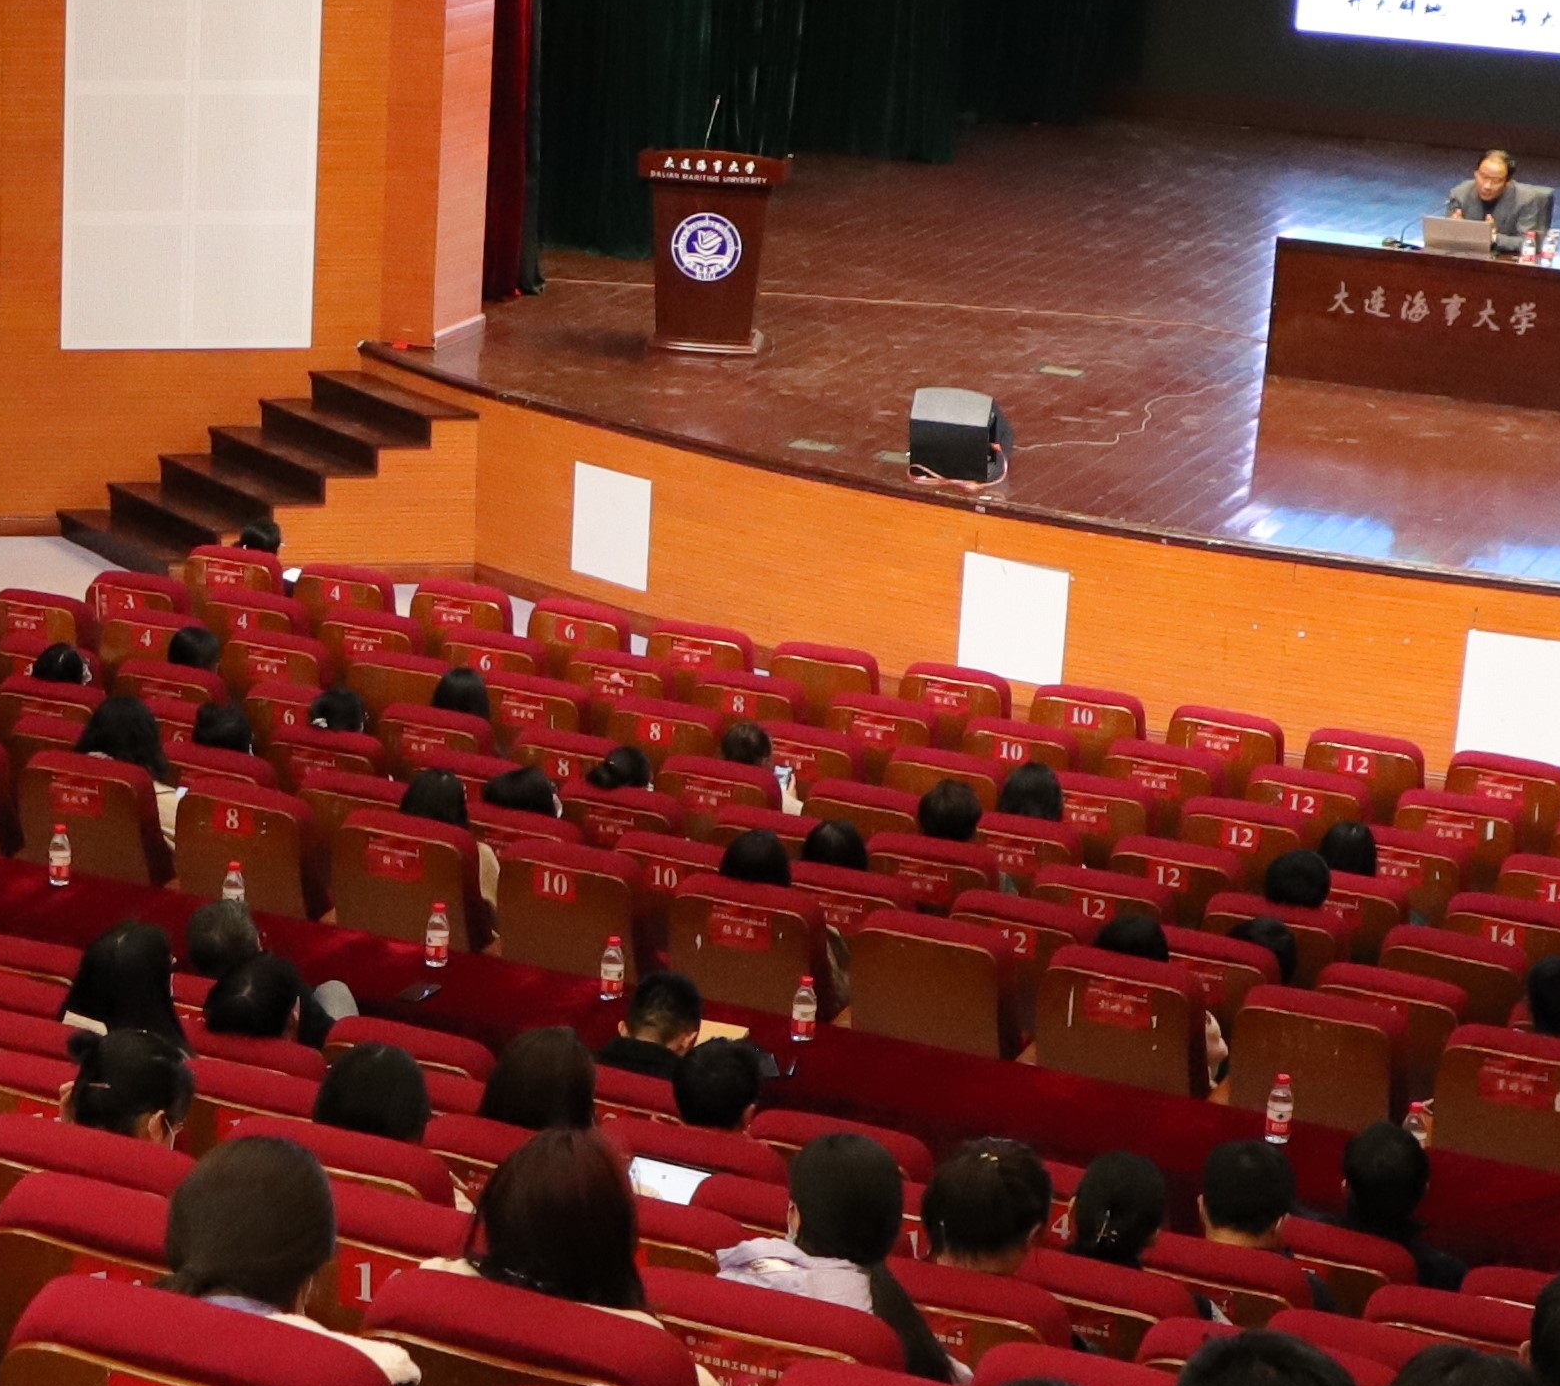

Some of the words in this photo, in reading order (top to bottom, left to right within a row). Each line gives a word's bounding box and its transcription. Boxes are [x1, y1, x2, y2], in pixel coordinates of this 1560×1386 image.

[1327, 280, 1539, 336] 大连海事大学
[330, 584, 341, 602] 4
[999, 742, 1023, 761] 10
[1344, 754, 1370, 774] 12
[1288, 793, 1314, 813] 12
[1227, 827, 1253, 847] 12
[540, 870, 569, 897] 10
[652, 864, 678, 890] 10
[1155, 865, 1181, 887] 12
[1080, 897, 1106, 918] 12
[1489, 925, 1515, 946] 14
